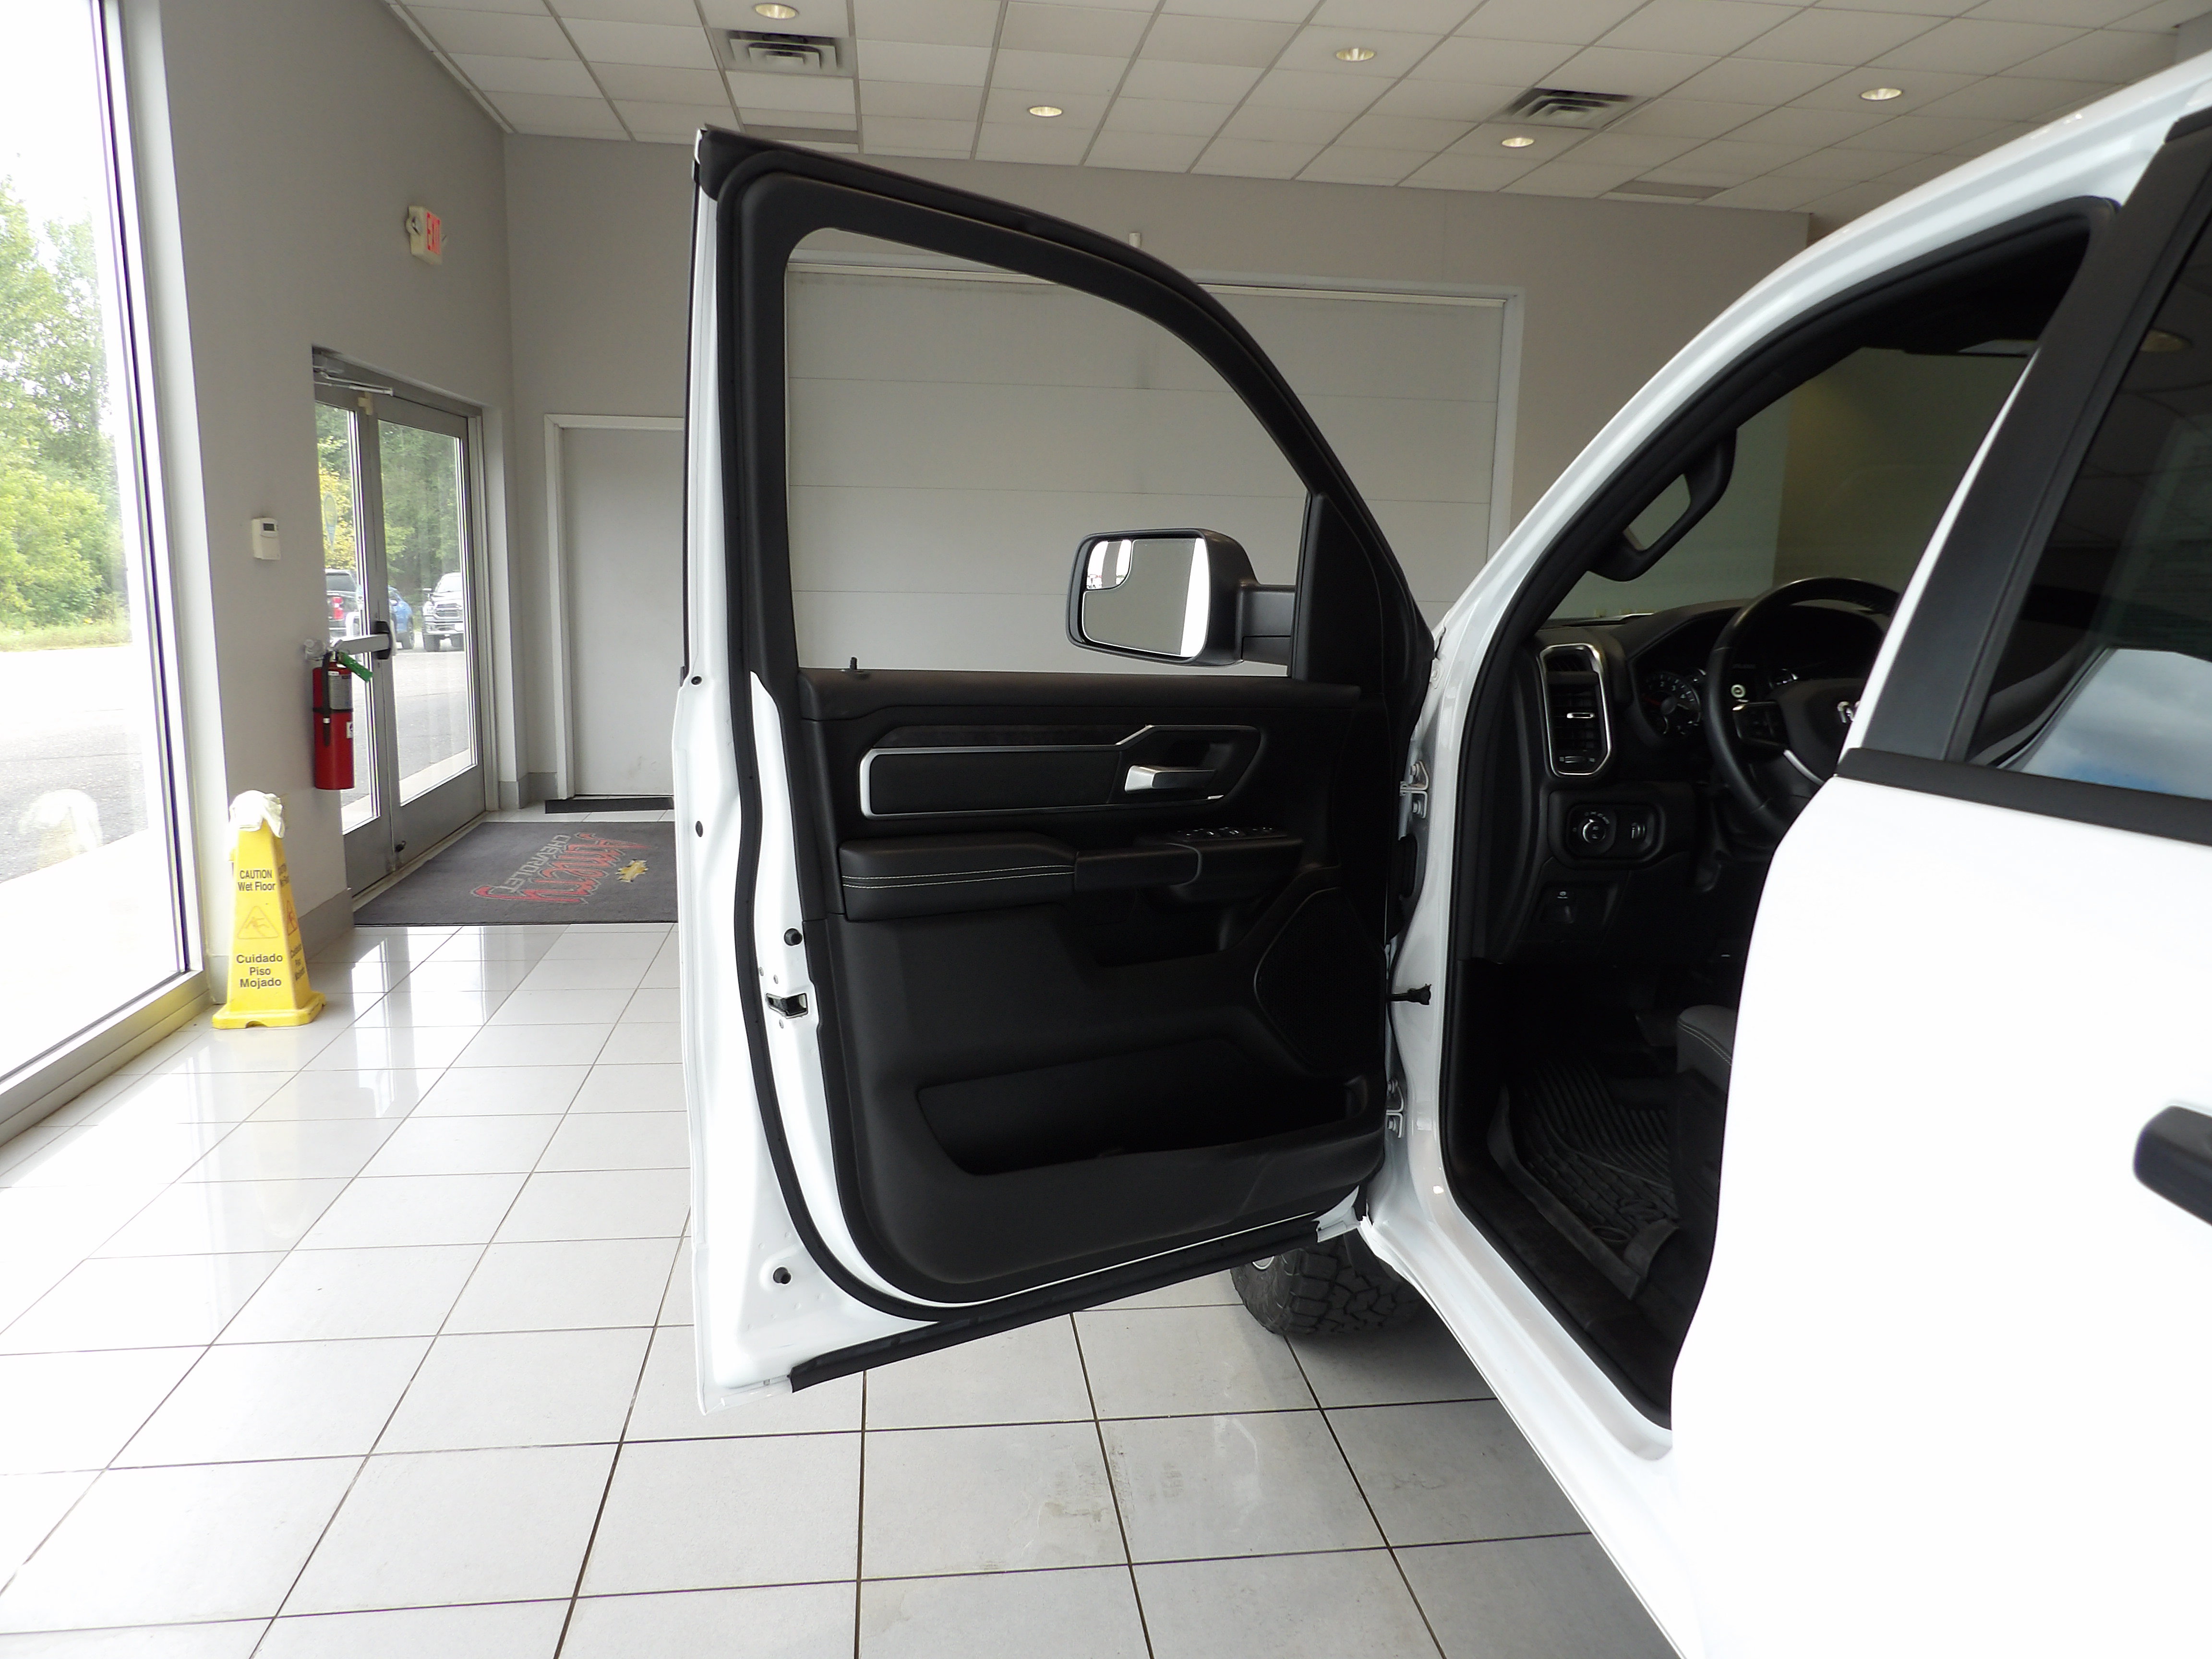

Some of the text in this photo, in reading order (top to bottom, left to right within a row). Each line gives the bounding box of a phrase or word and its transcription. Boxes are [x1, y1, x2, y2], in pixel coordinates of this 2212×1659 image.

[469, 832, 655, 903] Amery
[496, 834, 571, 893] CHEVROLET
[240, 869, 272, 879] CAUTION
[238, 882, 253, 891] Wet
[254, 881, 276, 890] Floor
[236, 953, 283, 963] Cuidado
[249, 967, 271, 975] Piso
[240, 978, 282, 989] Mojado
